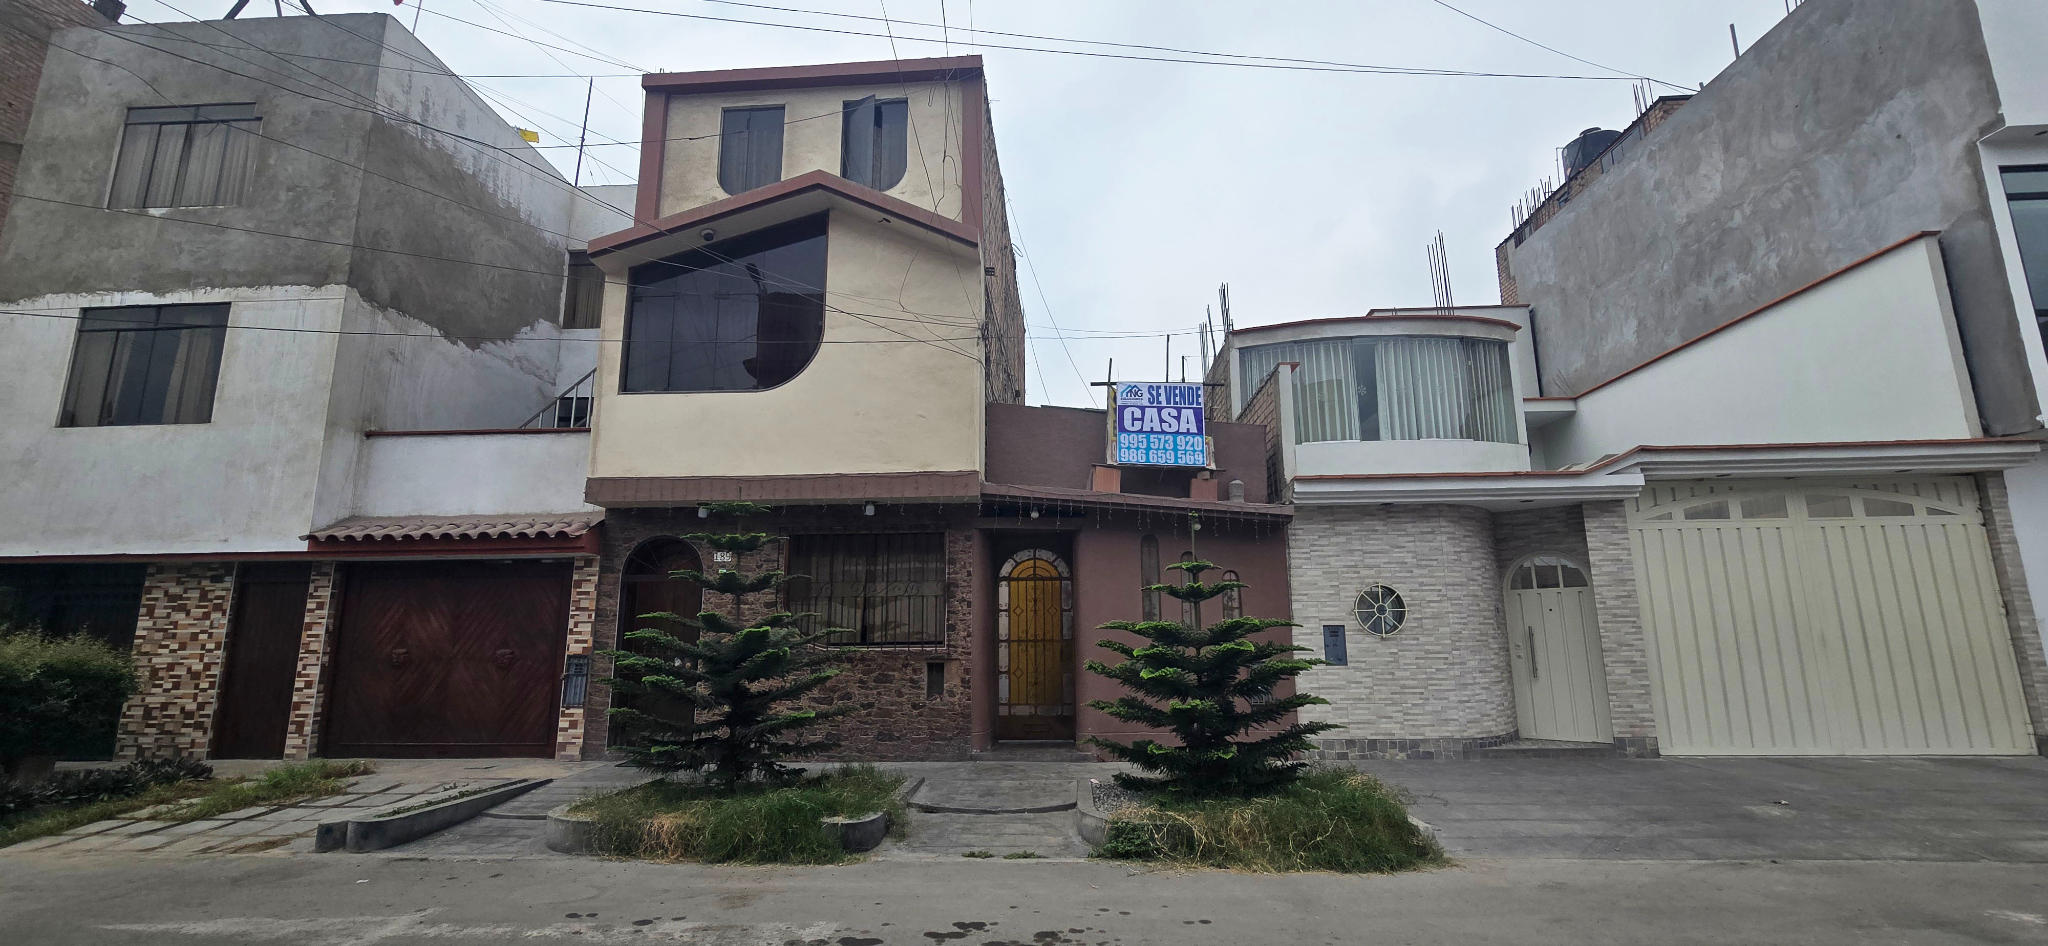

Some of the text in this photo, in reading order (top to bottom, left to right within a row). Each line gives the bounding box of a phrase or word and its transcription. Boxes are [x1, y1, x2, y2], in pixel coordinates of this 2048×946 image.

[1130, 389, 1143, 398] NG
[1148, 384, 1202, 406] SE VENDE
[1124, 407, 1198, 433] CASA
[1120, 434, 1202, 450] 995 573 920
[1120, 448, 1146, 462] 986
[1149, 450, 1174, 464] 659
[1178, 451, 1202, 464] 569
